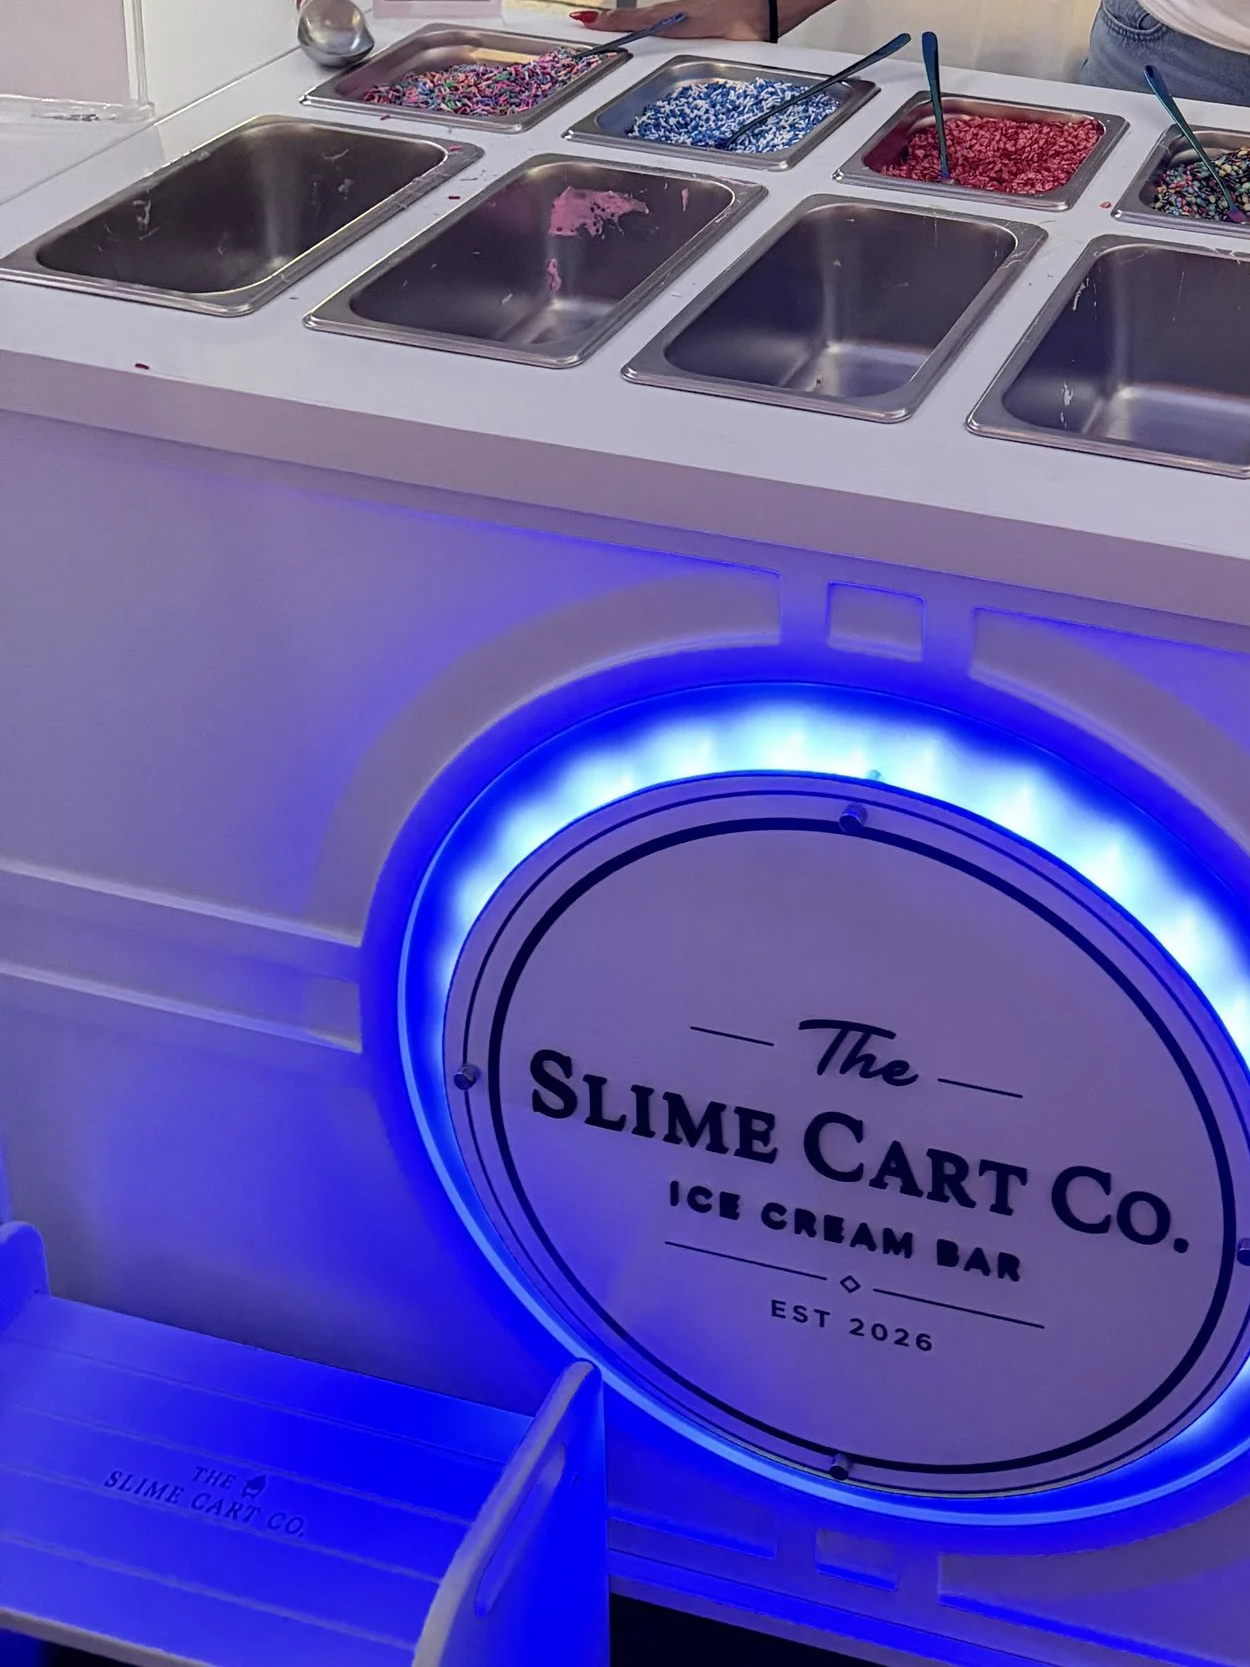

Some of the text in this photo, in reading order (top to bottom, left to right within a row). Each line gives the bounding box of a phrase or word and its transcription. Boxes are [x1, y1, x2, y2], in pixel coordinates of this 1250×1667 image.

[798, 1017, 920, 1088] The
[529, 1048, 1191, 1255] SLIME CART CO.
[668, 1179, 1022, 1284] ICE CREAM BAR
[770, 1298, 934, 1353] EST 2026
[104, 1470, 305, 1538] SLIME CART CO.
[192, 1466, 237, 1490] THE
